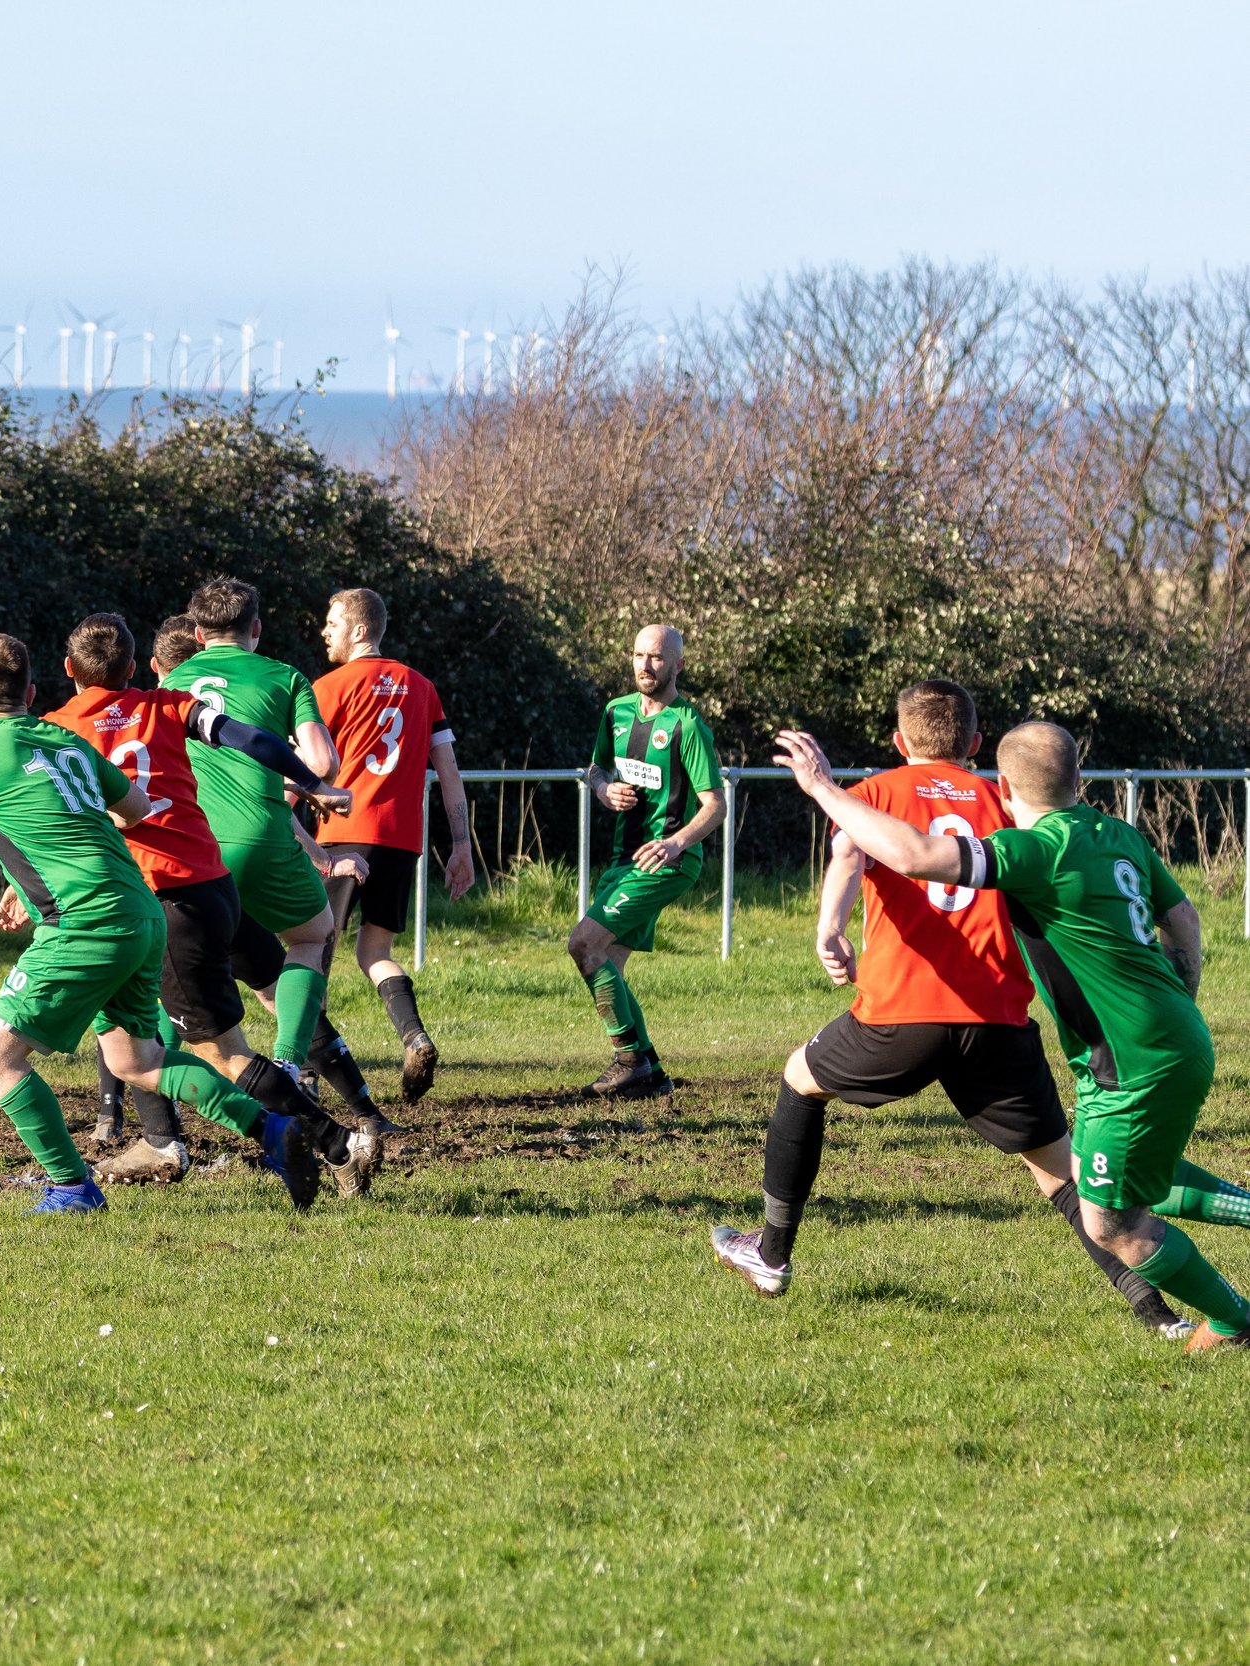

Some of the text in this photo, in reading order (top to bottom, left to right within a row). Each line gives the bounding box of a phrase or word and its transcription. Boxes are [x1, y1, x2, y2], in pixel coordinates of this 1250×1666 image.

[190, 676, 228, 714] 6
[93, 713, 141, 728] RG HOWELLS
[365, 706, 404, 776] 3
[22, 747, 107, 813] 10
[110, 739, 173, 820] 2
[916, 785, 976, 796] RG HOWELLS
[615, 892, 630, 908] 7
[1114, 859, 1157, 946] 8
[7, 965, 27, 991] 10
[1092, 1152, 1108, 1175] 8
